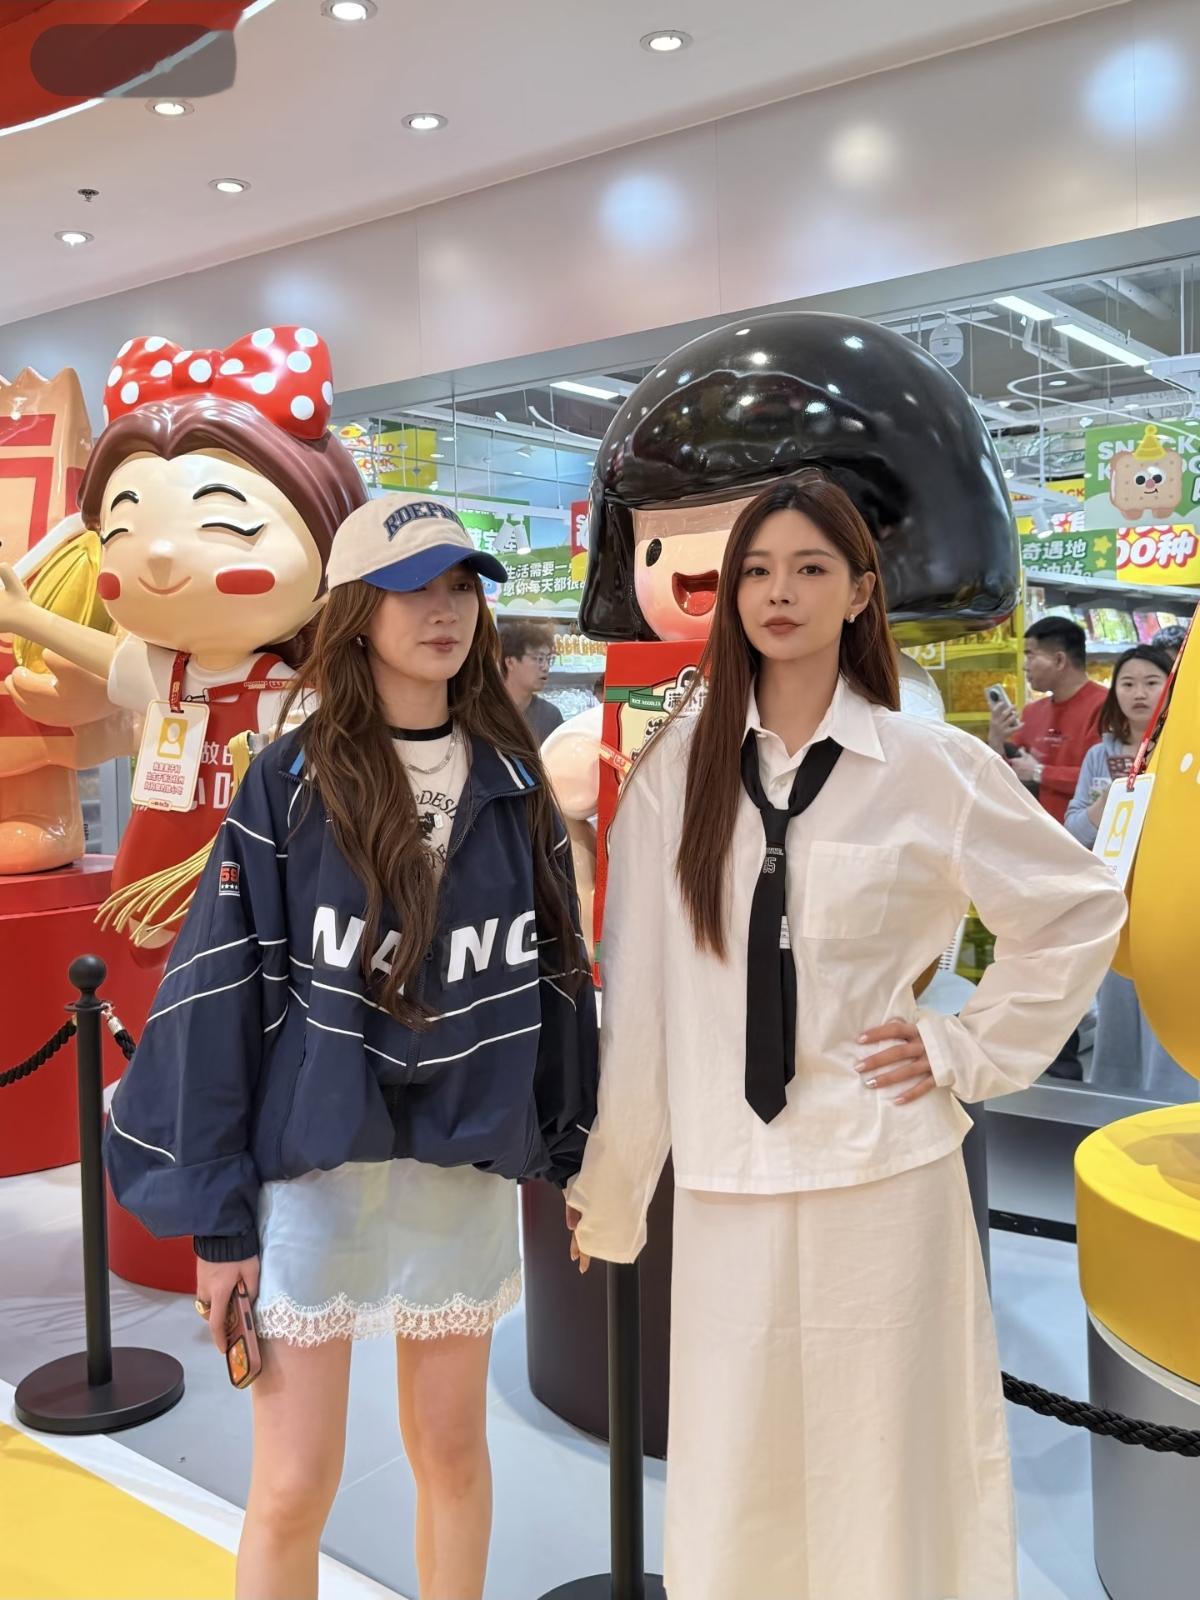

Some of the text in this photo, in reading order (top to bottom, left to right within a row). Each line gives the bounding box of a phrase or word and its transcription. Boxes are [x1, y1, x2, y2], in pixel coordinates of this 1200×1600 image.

[1098, 435, 1198, 461] SNCK
[503, 576, 586, 597] 愿你每天都很
